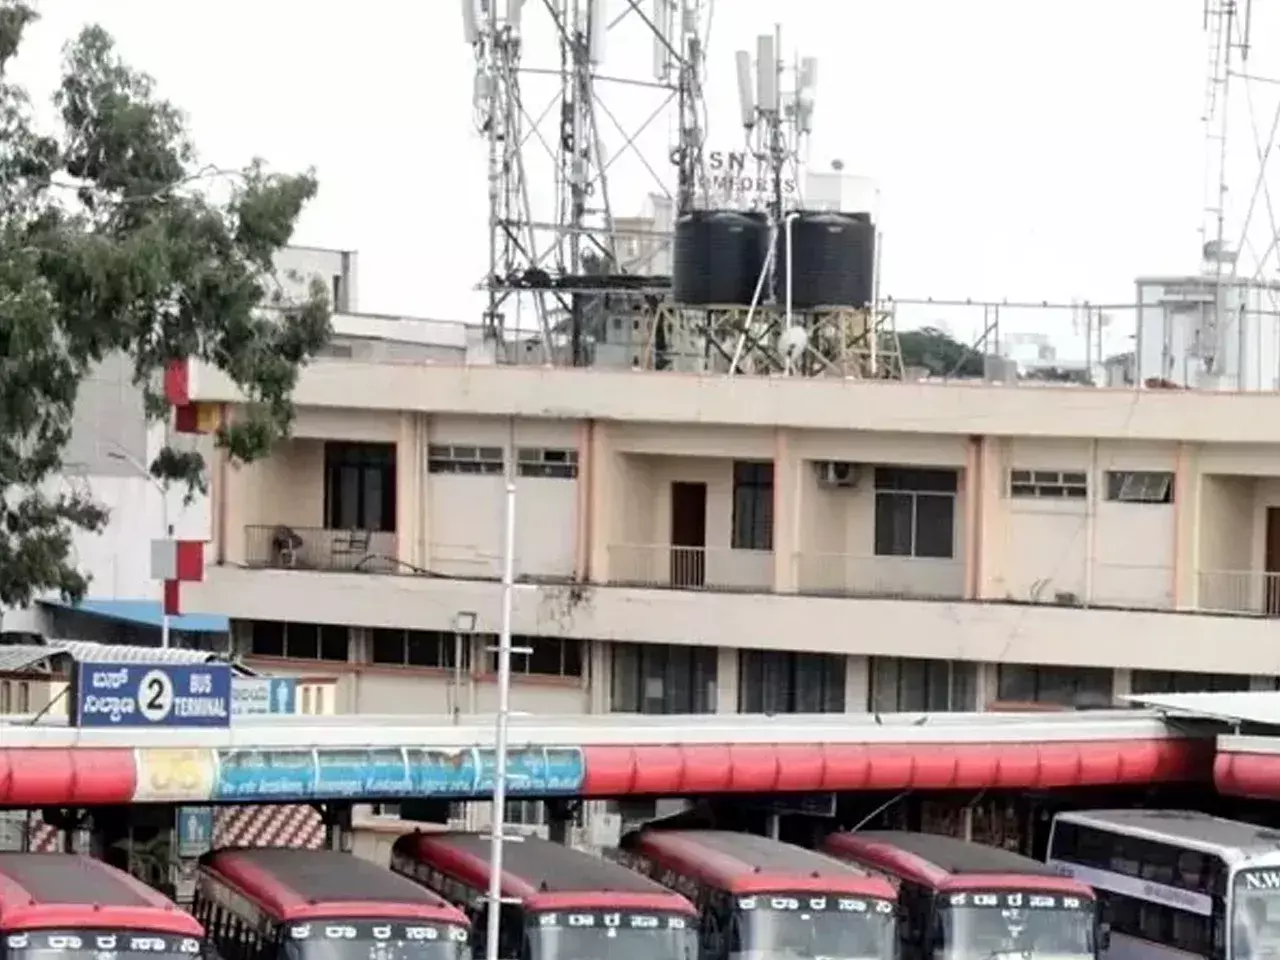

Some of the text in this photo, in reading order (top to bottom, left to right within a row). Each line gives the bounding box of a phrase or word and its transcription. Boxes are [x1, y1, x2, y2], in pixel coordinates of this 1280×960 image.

[146, 677, 165, 711] 2
[189, 674, 212, 693] BUS
[174, 697, 227, 718] TERMINAL
